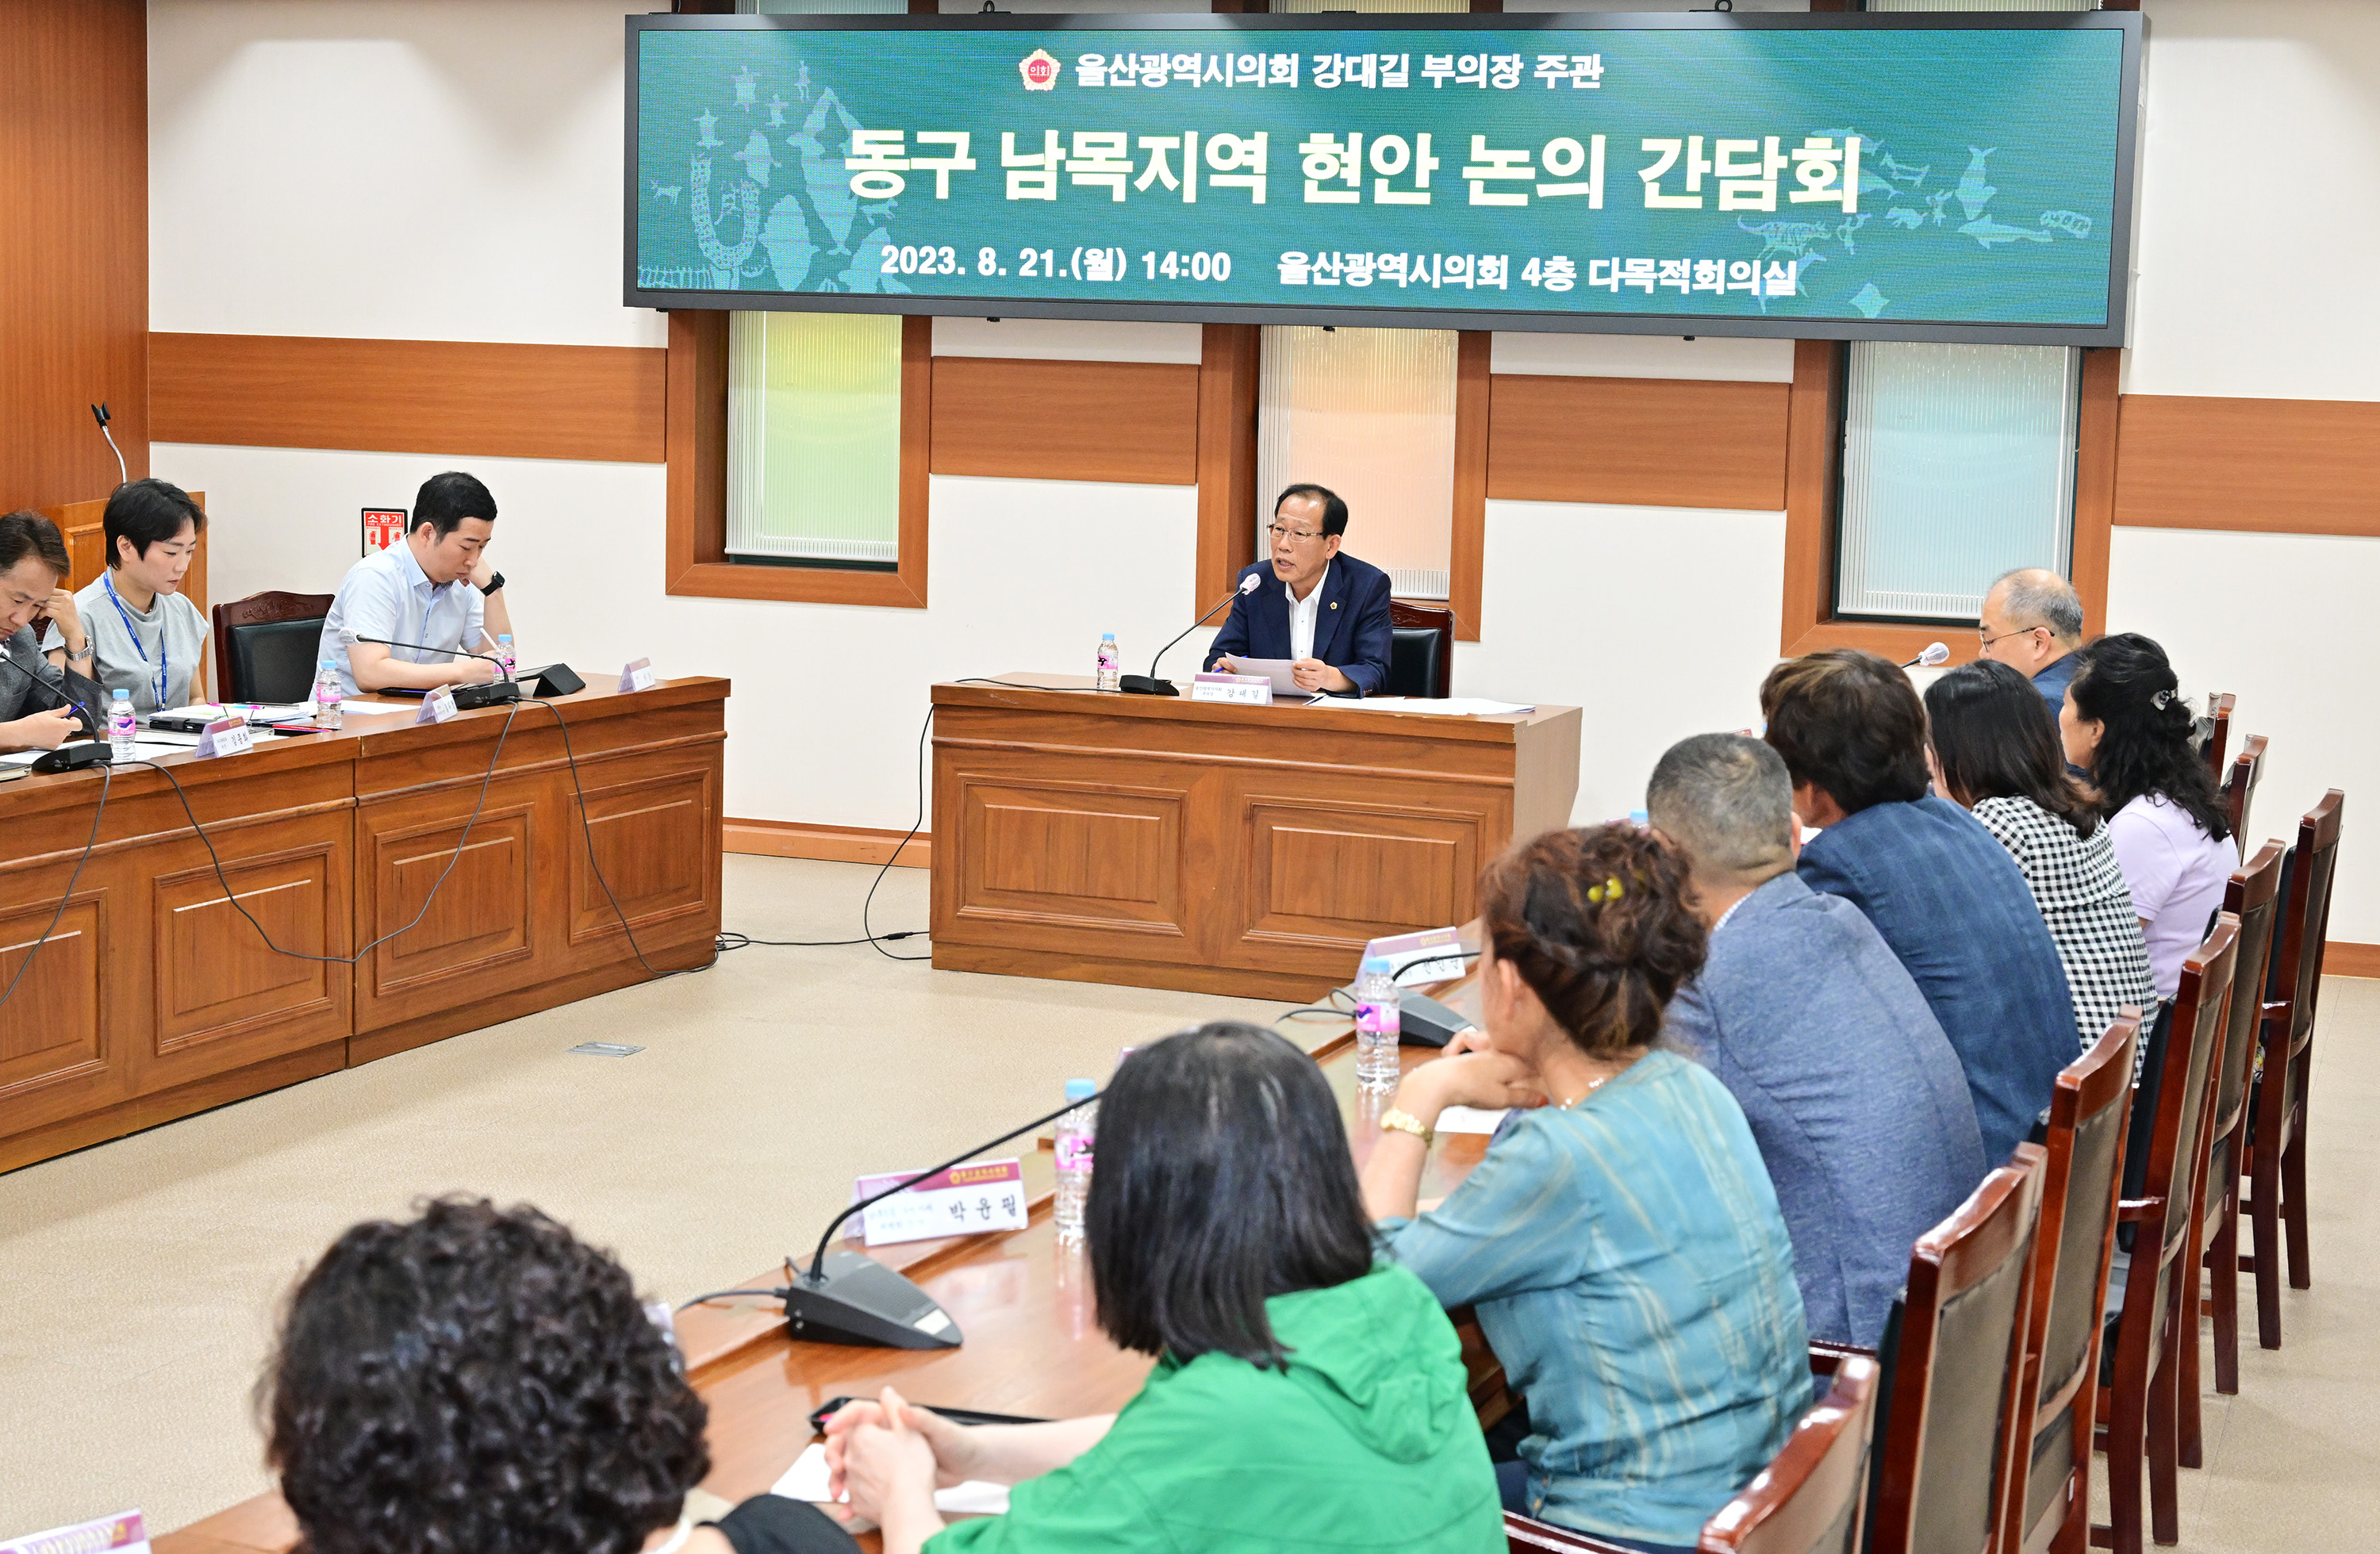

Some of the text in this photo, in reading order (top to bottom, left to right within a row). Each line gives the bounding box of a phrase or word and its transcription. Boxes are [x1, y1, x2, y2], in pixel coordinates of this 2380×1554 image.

[1029, 64, 1050, 77] 의회
[1075, 52, 1604, 90] 울산광역시의회 강대길 부의장 주관
[845, 129, 1861, 213] 동구 남목지역 현안 논의 간담회
[881, 244, 965, 276] 2023.
[977, 247, 1007, 276] 8.
[1142, 251, 1231, 282] 14:00
[1277, 251, 1509, 290] 울산광역시의회
[1521, 255, 1577, 292] 4층
[1588, 257, 1797, 297] 다목적회의실
[367, 514, 401, 524] 소화기
